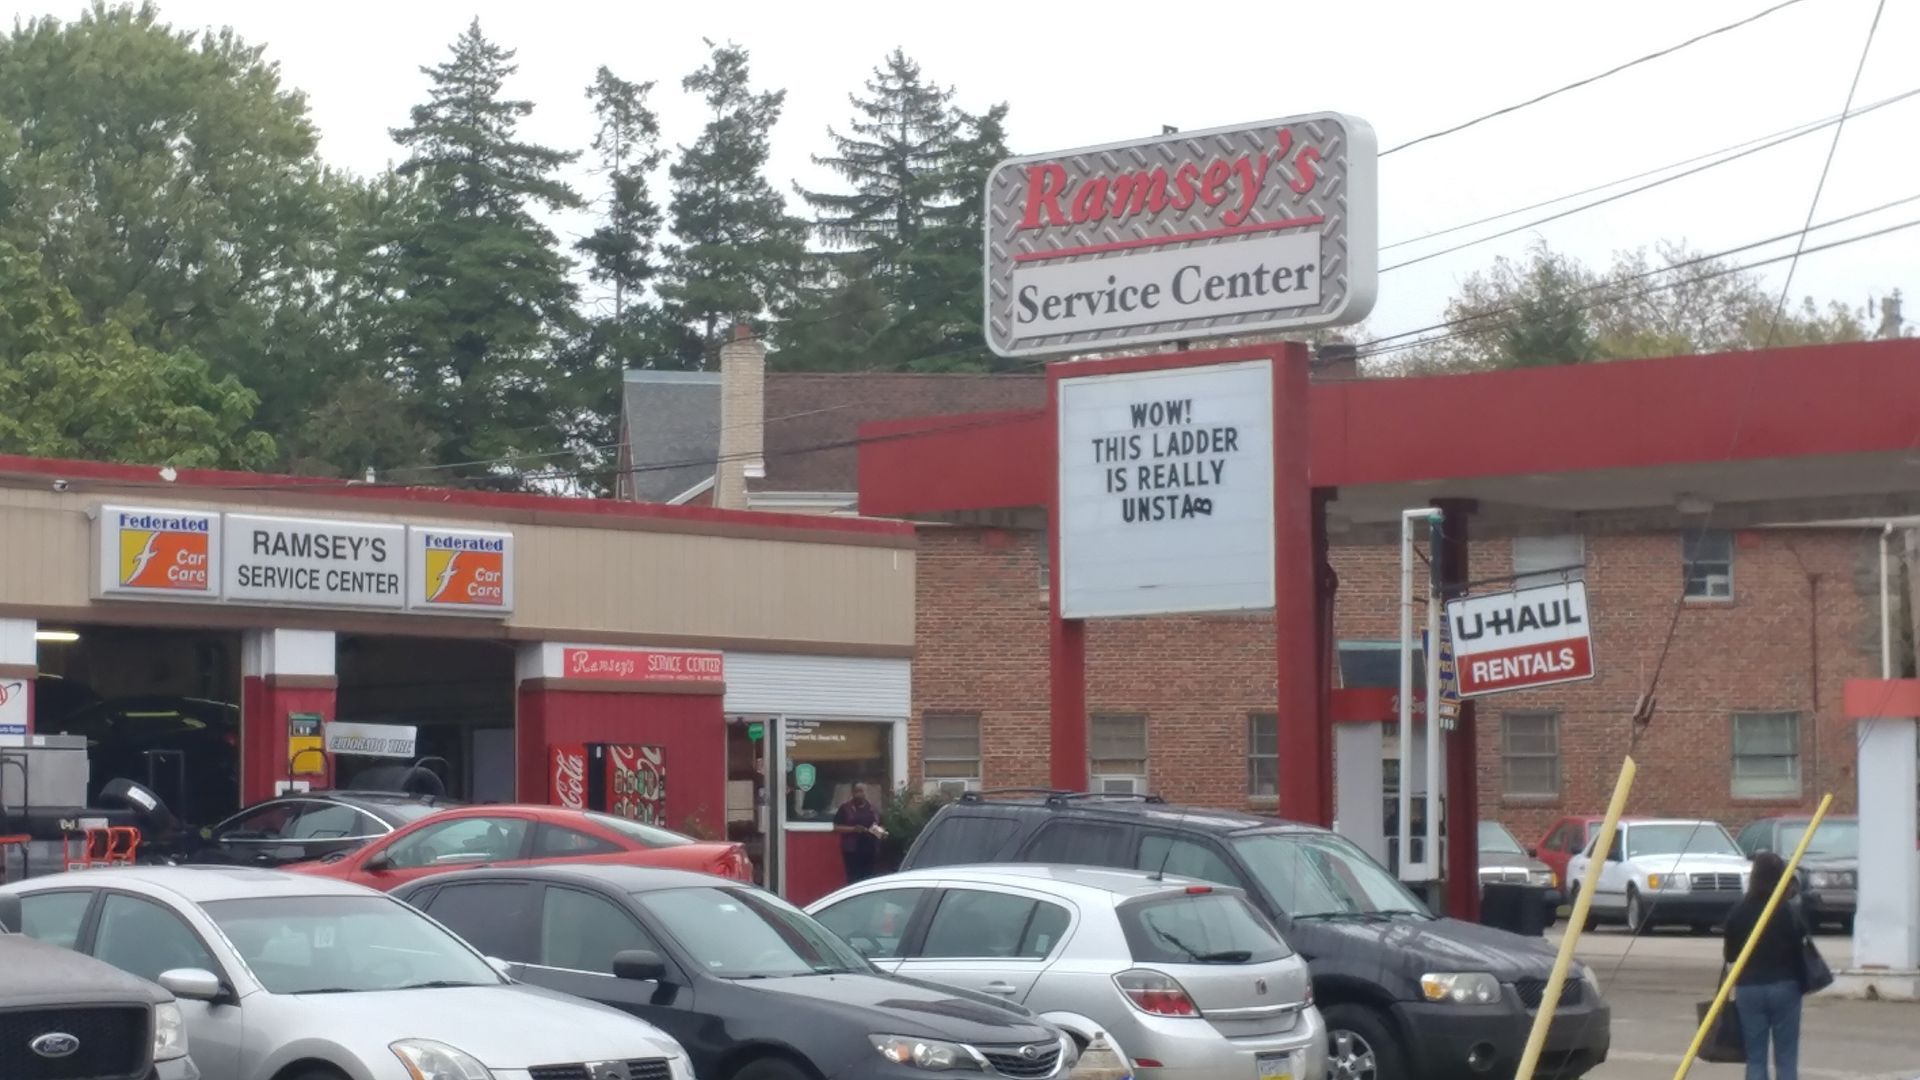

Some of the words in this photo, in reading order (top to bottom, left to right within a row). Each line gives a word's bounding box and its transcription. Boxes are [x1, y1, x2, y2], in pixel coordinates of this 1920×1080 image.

[1018, 128, 1321, 230] Ramsey's
[1016, 275, 1161, 324] Service
[1171, 263, 1316, 305] Center
[1130, 399, 1193, 429] WOW!
[1091, 434, 1142, 464] THIS
[1152, 427, 1239, 458] LADDER
[1106, 467, 1128, 493] IS
[1137, 459, 1225, 491] REALLY
[119, 513, 209, 532] Federated
[176, 548, 206, 565] Car
[253, 529, 387, 563] RAMSEY'S
[425, 533, 503, 551] Federated
[167, 565, 206, 582] Care
[238, 564, 320, 591] SERVICE
[326, 569, 399, 595] CENTER
[475, 567, 501, 582] Car
[467, 582, 501, 597] Care
[1456, 598, 1582, 641] U-HAUL
[647, 654, 682, 673] SERVICE
[686, 656, 721, 673] CENTER
[1471, 647, 1576, 684] RENTALS
